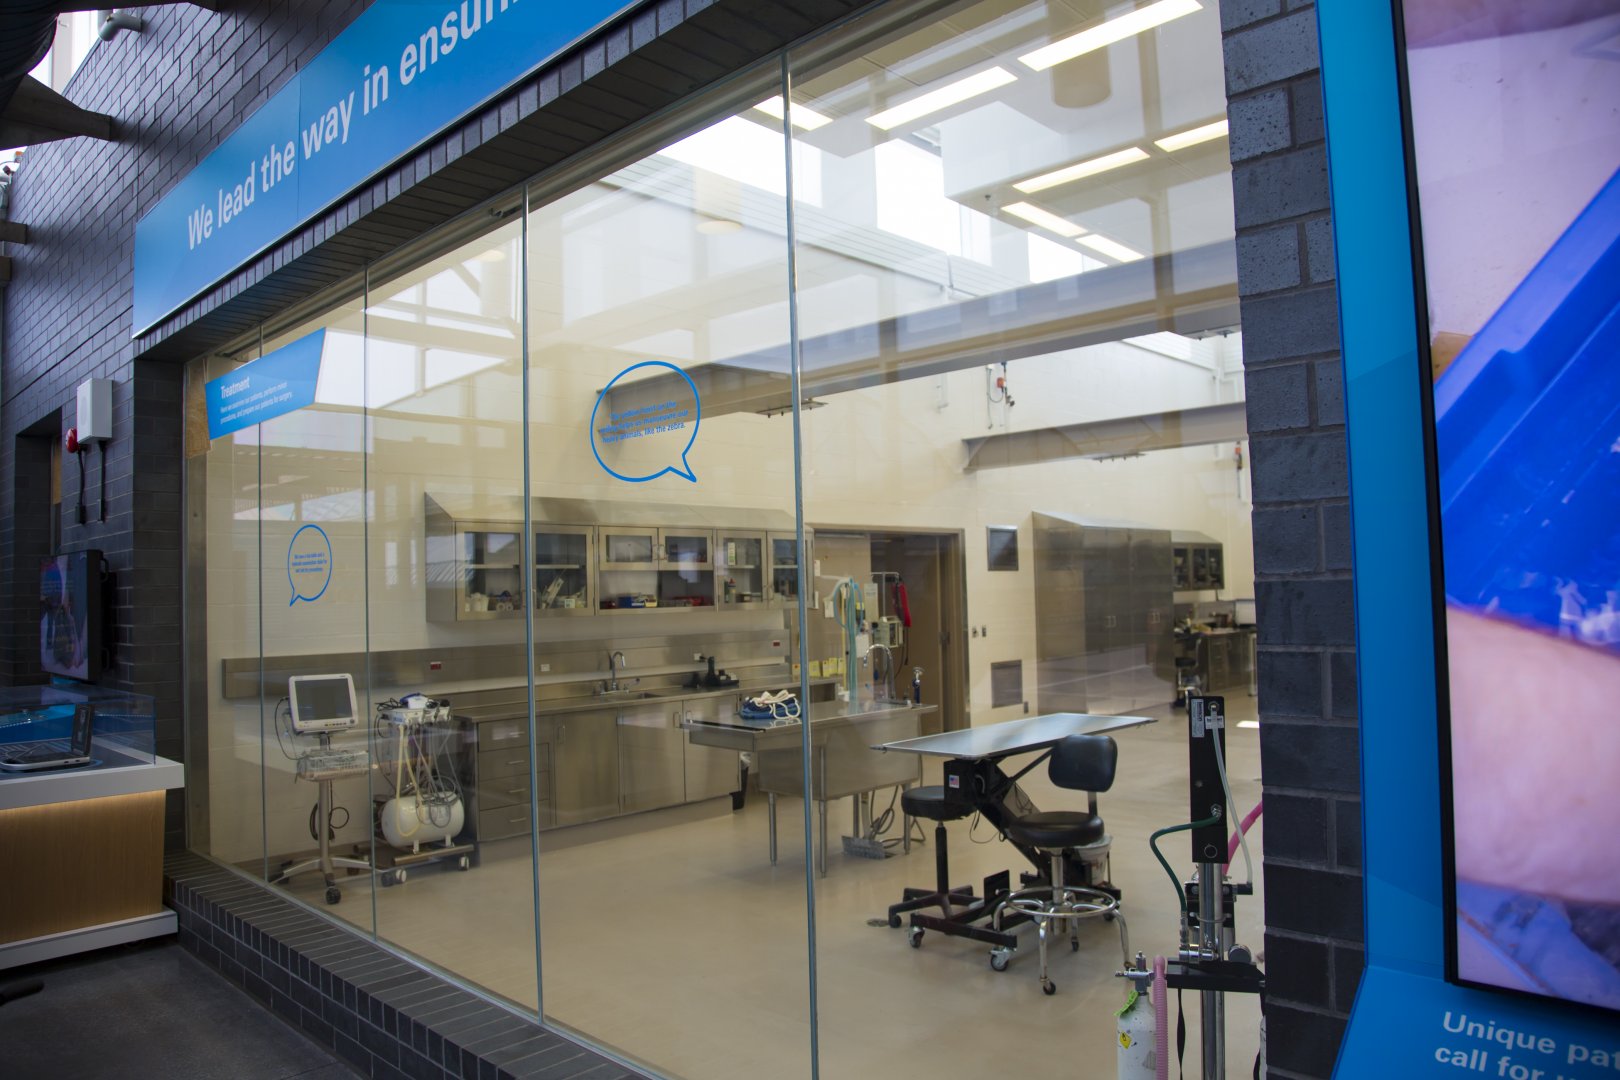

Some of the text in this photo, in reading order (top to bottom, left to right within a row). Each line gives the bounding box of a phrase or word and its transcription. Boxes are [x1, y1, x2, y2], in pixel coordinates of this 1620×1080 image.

[188, 204, 213, 250] We
[218, 159, 256, 229] lead
[261, 141, 295, 193] the
[302, 91, 355, 160] way
[363, 64, 389, 116] in
[221, 376, 250, 399] Treatment
[644, 427, 655, 436] like
[656, 425, 666, 433] the
[668, 422, 685, 431] zebra.
[1443, 1011, 1556, 1054] Unique
[1435, 1047, 1545, 1080] call for
